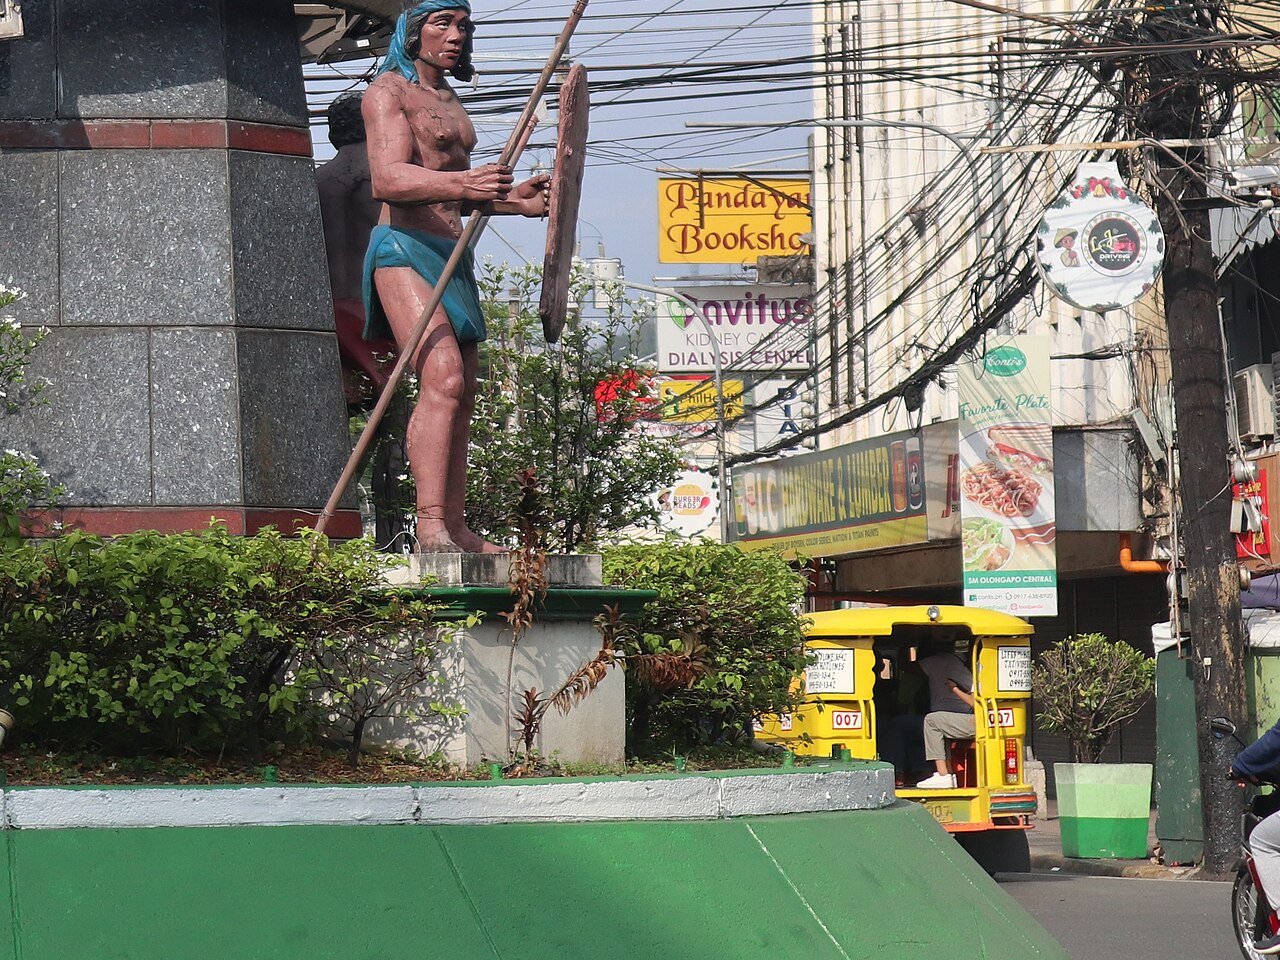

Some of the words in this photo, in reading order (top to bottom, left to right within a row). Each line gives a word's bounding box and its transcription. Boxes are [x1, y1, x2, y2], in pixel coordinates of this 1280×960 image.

[686, 332, 741, 347] KIDNEY
[668, 351, 743, 367] DIALYSIS
[959, 396, 1009, 421] Favorite
[1015, 393, 1051, 411] Plate
[847, 446, 892, 519] LUMBER
[980, 576, 1022, 584] OLONGAPO
[1022, 575, 1053, 583] CENTRAL
[835, 714, 859, 726] 007
